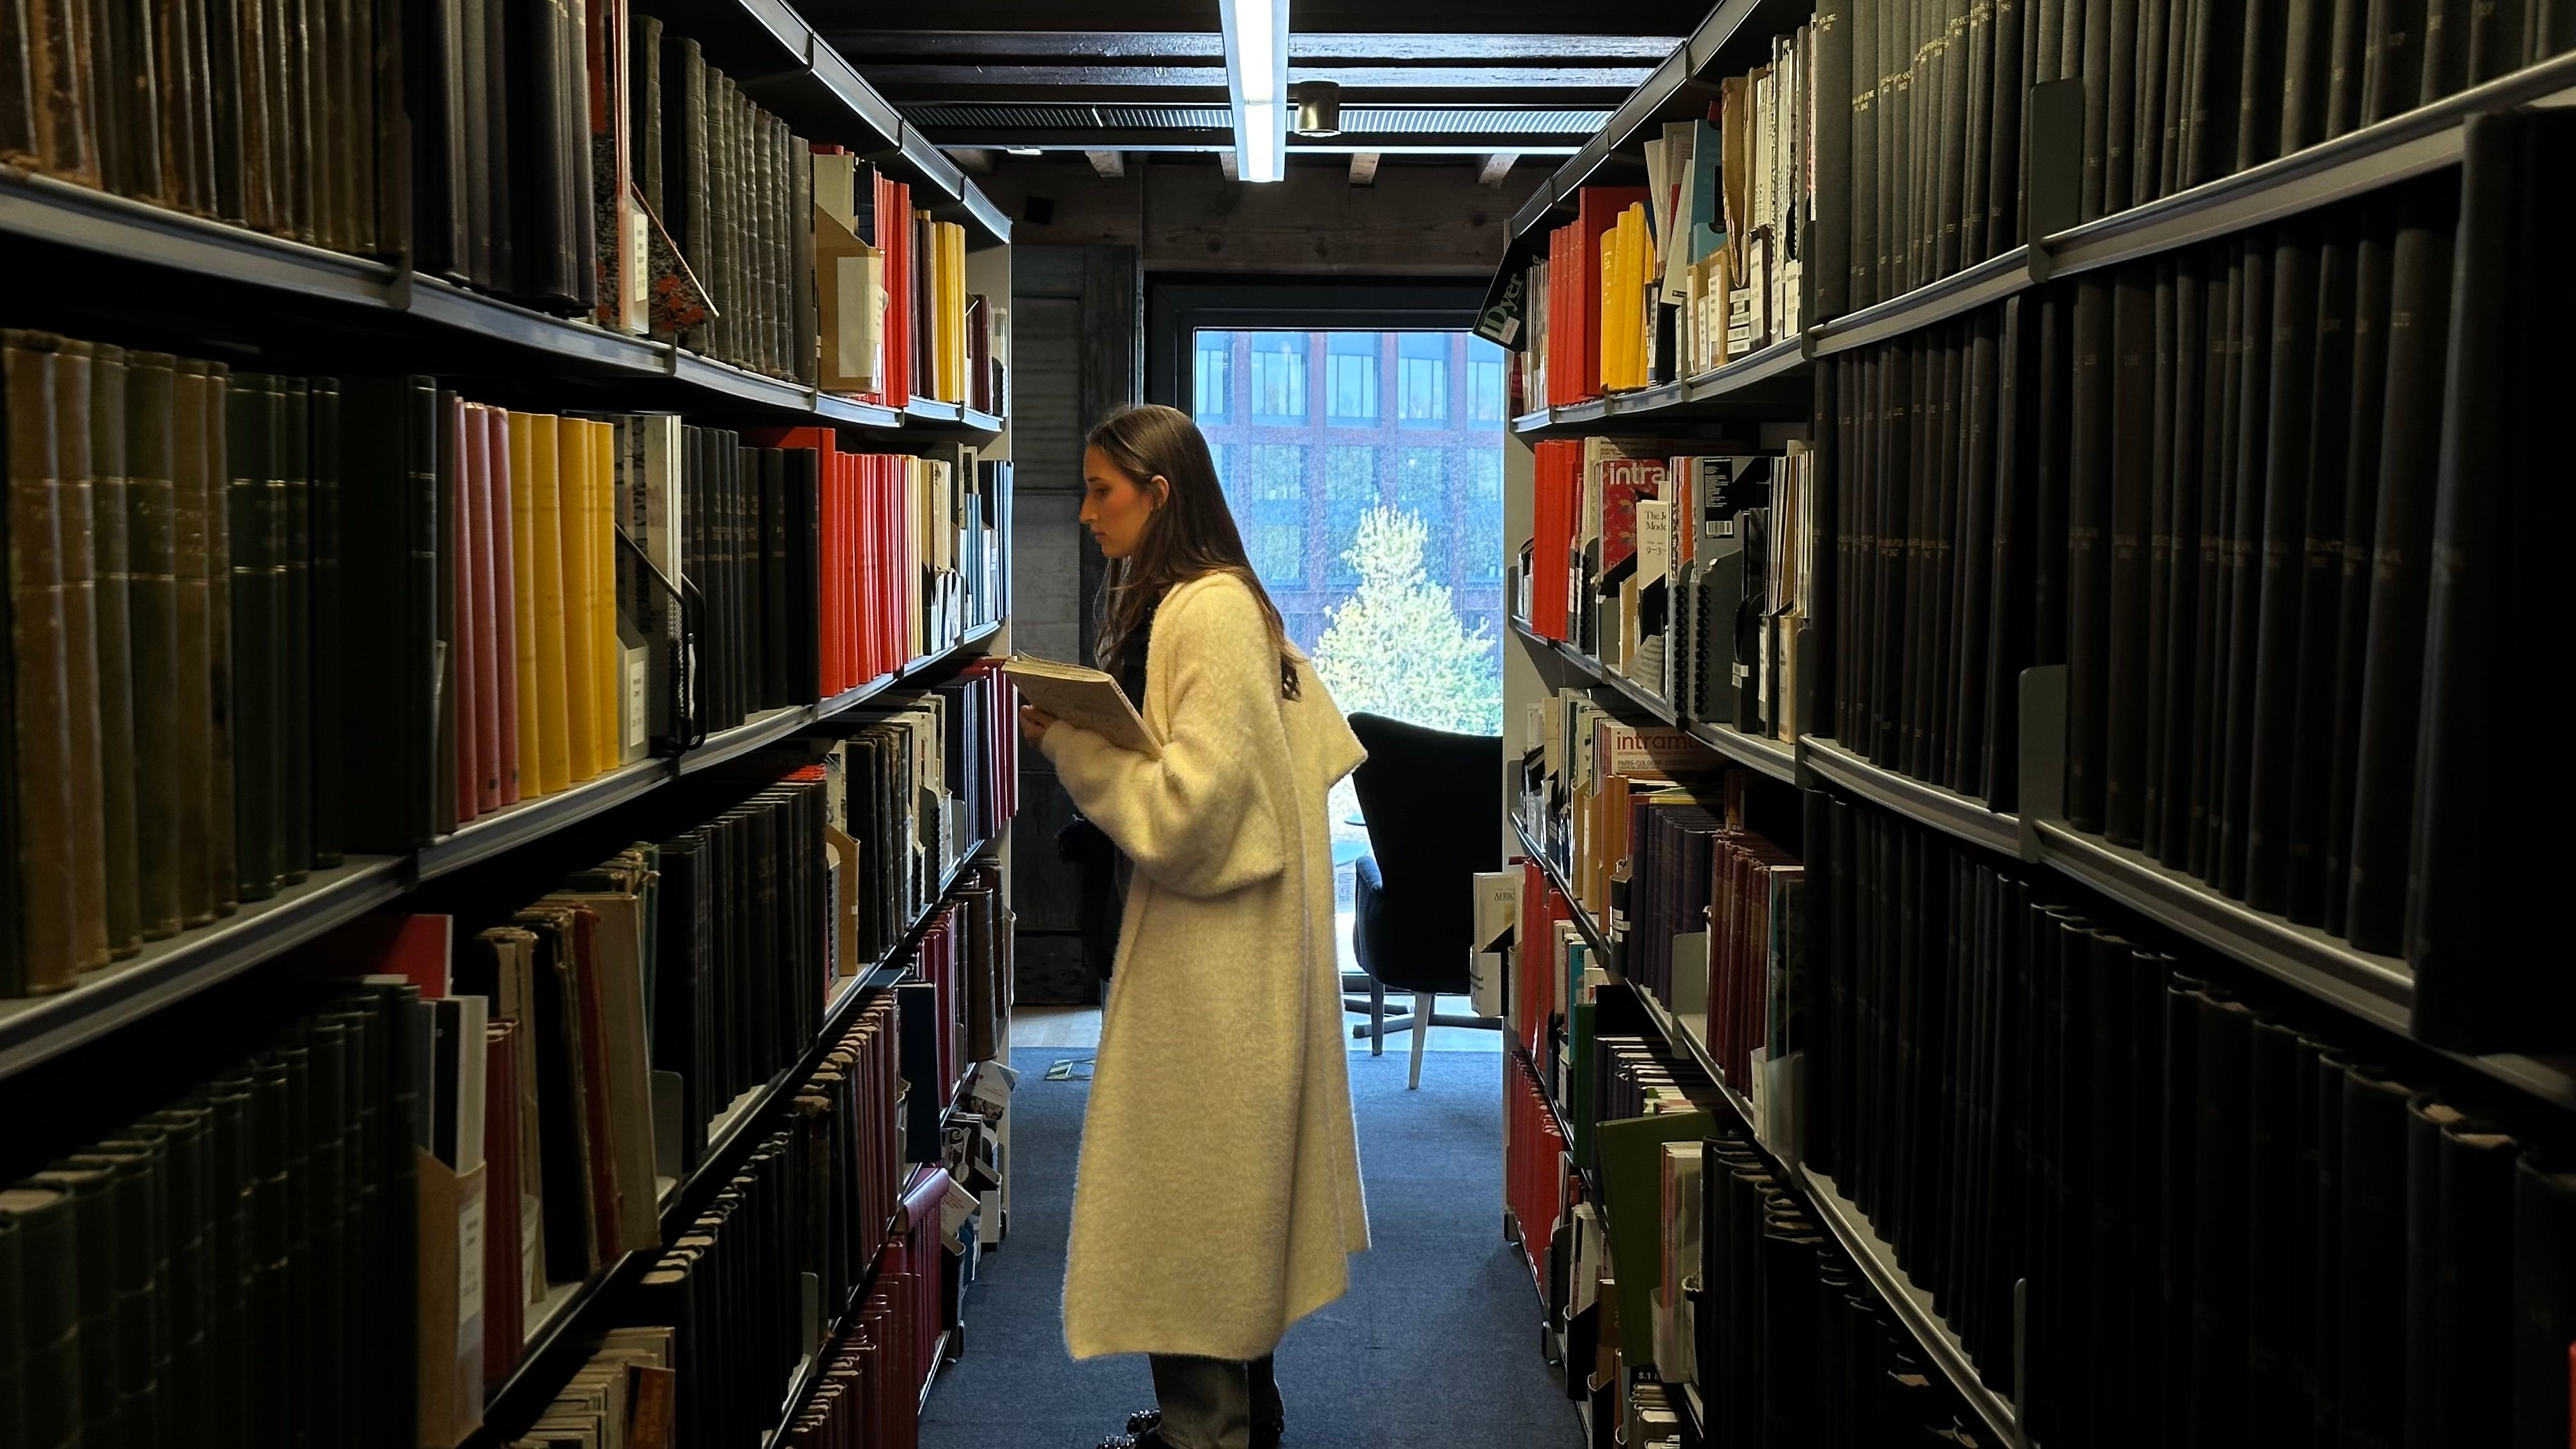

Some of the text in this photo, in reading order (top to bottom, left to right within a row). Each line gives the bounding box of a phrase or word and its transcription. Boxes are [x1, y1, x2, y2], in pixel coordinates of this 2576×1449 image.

[1482, 272, 1524, 334] Dyer
[1609, 462, 1670, 485] intra
[1644, 510, 1660, 520] The
[1617, 732, 1705, 750] intramu
